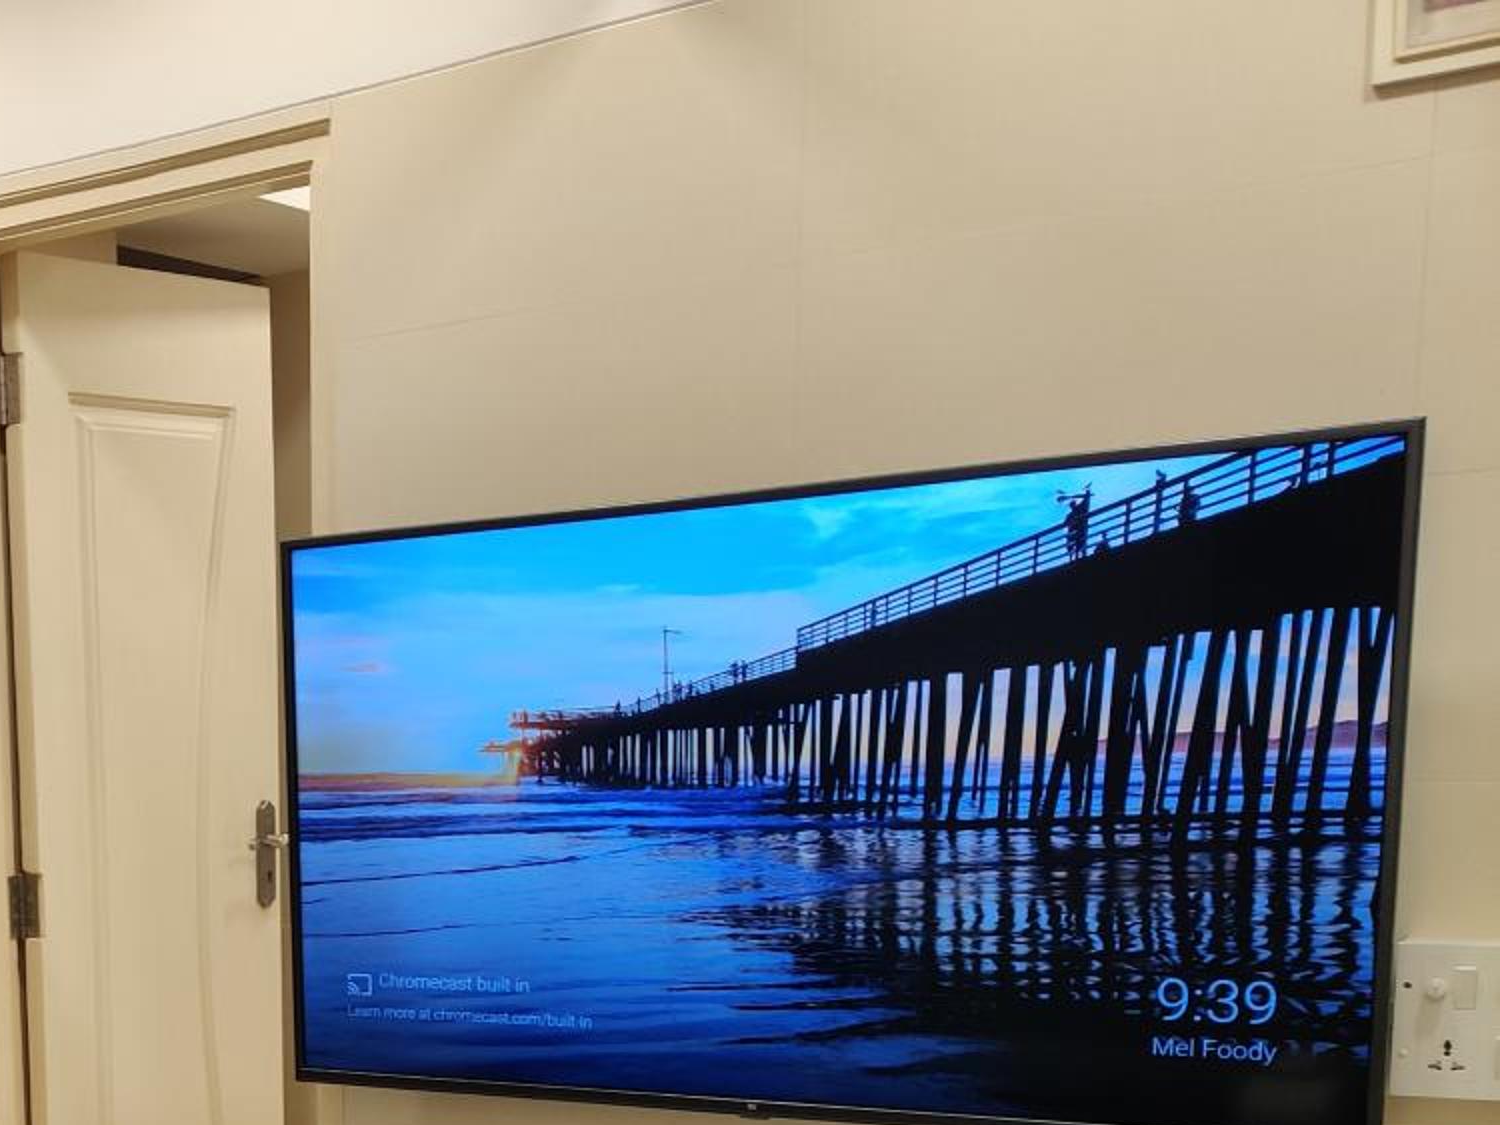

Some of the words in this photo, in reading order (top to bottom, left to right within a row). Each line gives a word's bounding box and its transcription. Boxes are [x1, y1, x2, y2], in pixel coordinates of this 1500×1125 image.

[379, 972, 472, 992] Chromecast
[1157, 977, 1277, 1025] 9:39
[1152, 1036, 1195, 1057] Mel
[1202, 1038, 1277, 1066] Foody
